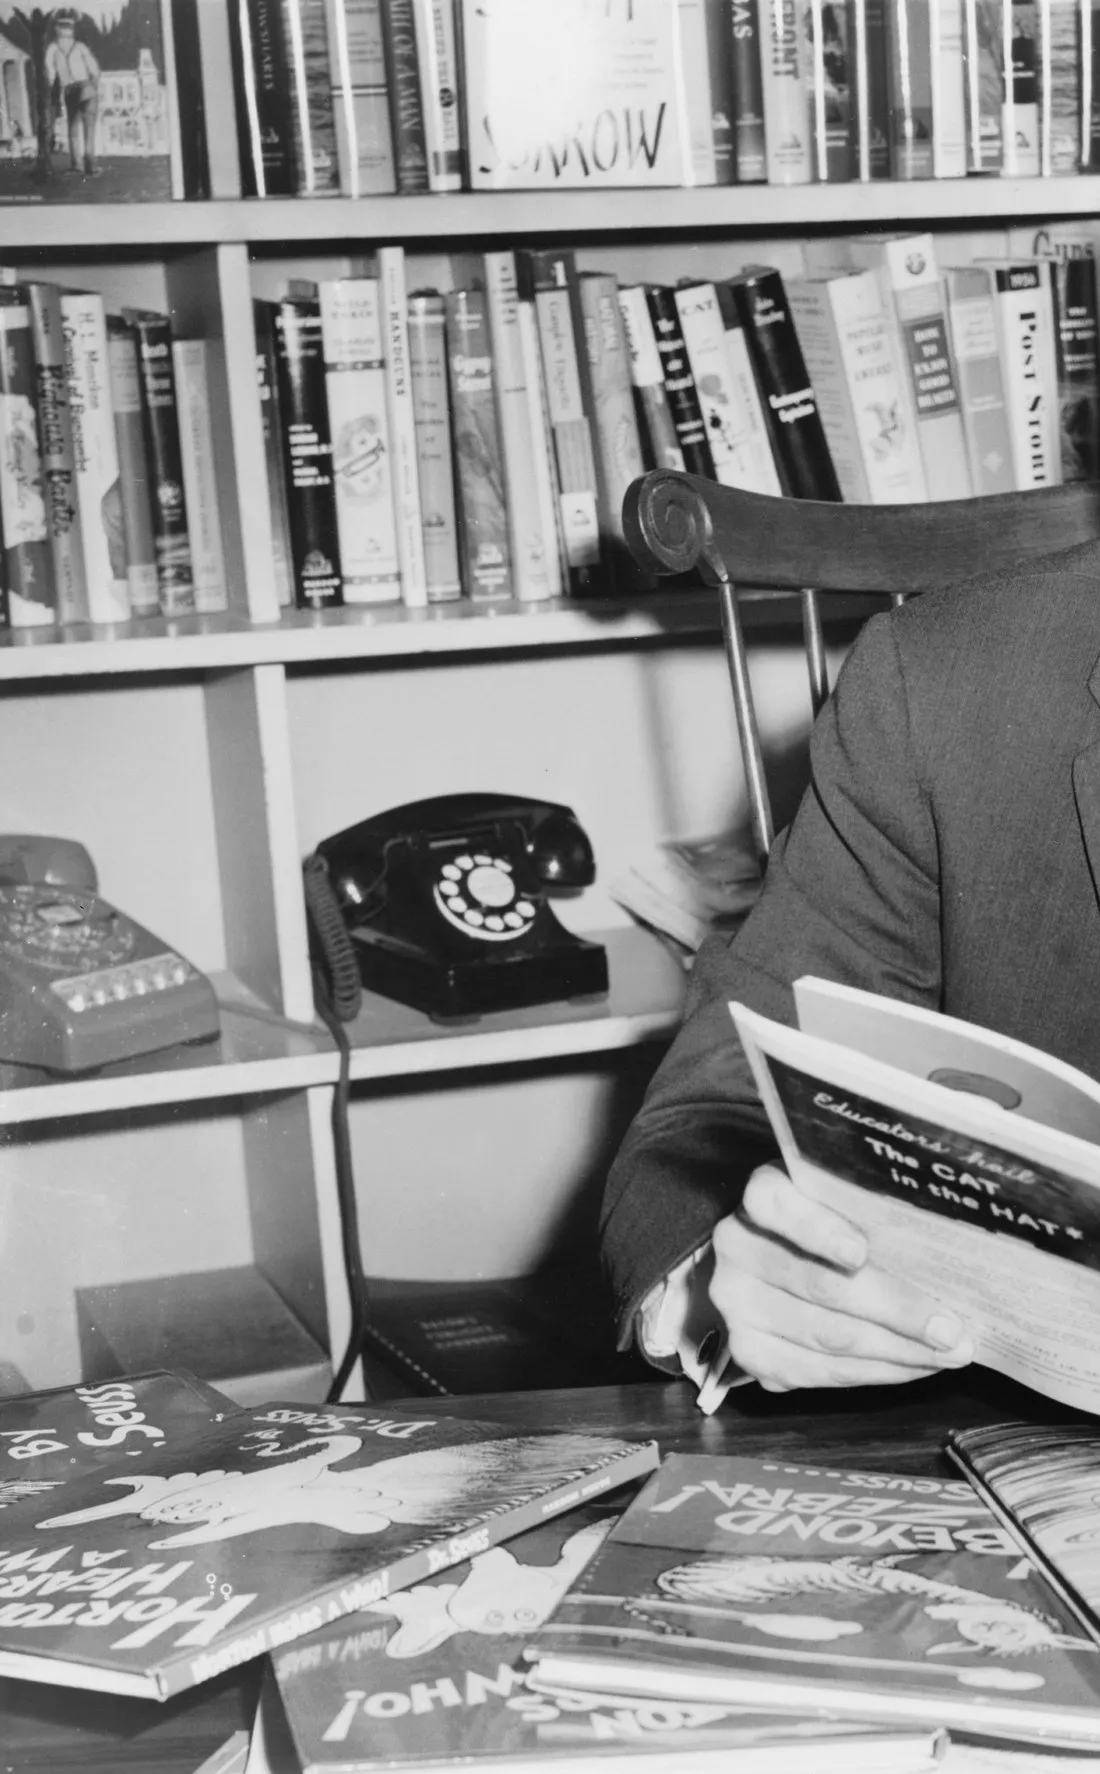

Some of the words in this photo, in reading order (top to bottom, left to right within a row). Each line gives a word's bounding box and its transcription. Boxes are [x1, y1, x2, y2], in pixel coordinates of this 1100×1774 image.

[813, 1092, 950, 1155] Educators
[957, 1146, 1036, 1186] hail
[864, 1136, 920, 1172] The
[932, 1161, 1001, 1196] CAT
[891, 1168, 919, 1190] in
[928, 1180, 980, 1211] the
[990, 1202, 1059, 1237] HAT
[74, 1382, 165, 1447] Seuss
[81, 1549, 129, 1568] A
[714, 1509, 1025, 1556] BEYOND
[0, 1560, 195, 1599] HEAR
[322, 1664, 530, 1742] WHO!
